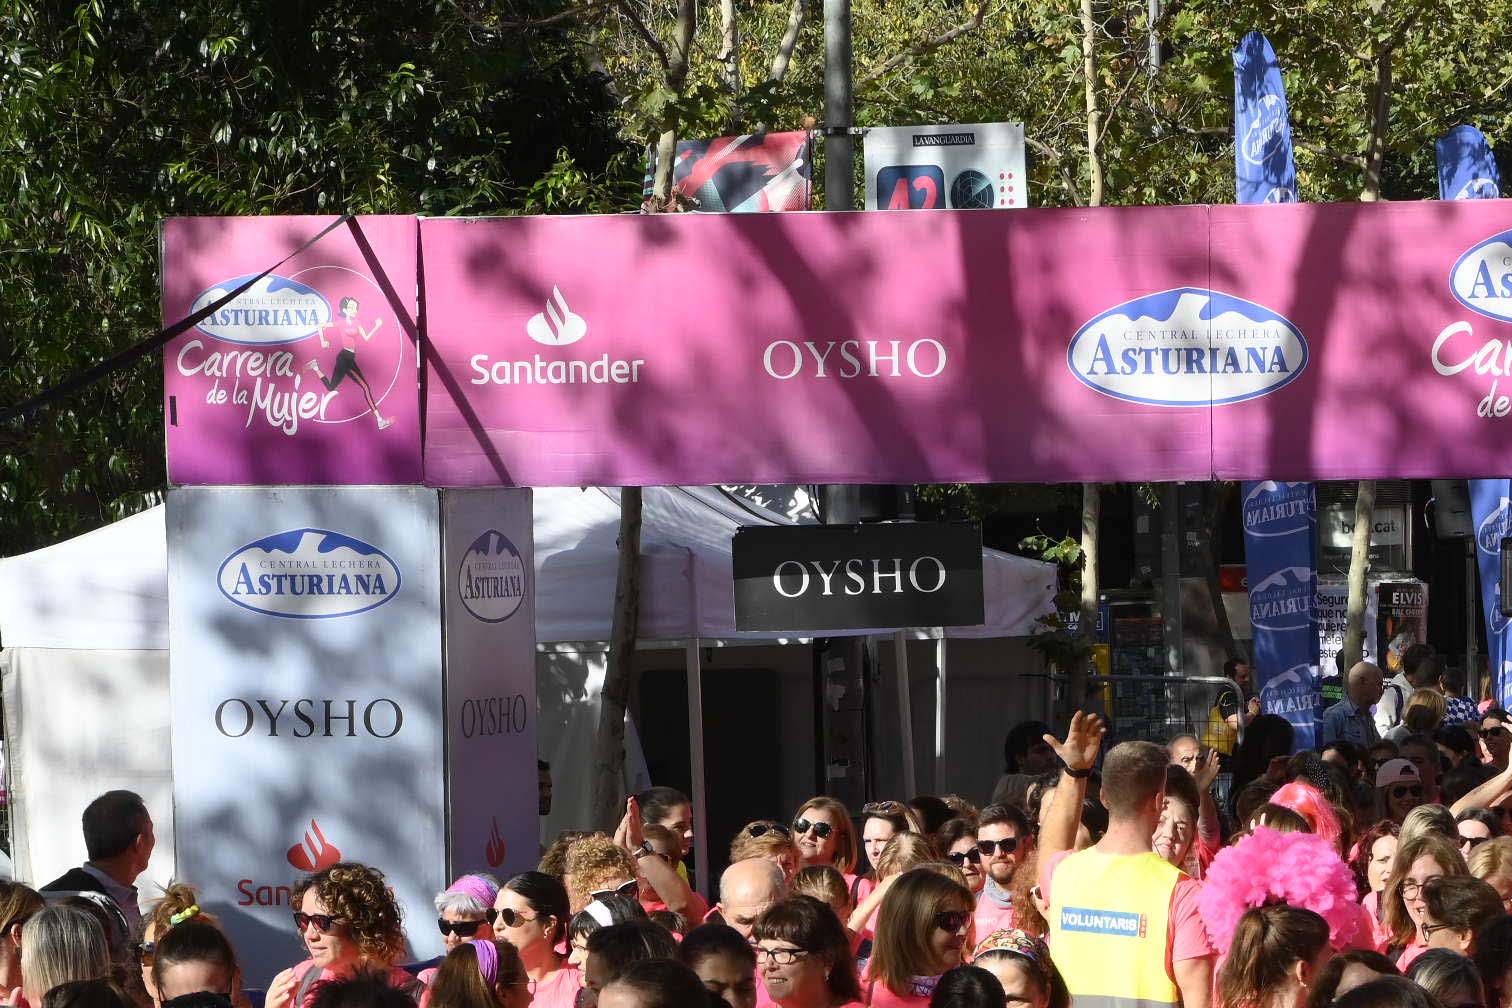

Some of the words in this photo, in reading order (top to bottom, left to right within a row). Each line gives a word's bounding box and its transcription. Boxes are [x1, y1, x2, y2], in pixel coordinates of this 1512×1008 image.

[201, 303, 319, 326] ASTURIANA
[1123, 329, 1201, 341] CENTRAL
[1206, 329, 1282, 341] LECHERA
[177, 340, 295, 377] Carrera
[470, 353, 645, 385] Santander
[763, 338, 947, 379] OYSHO
[1087, 333, 1291, 377] ASTURIANA
[206, 379, 228, 405] de
[232, 378, 249, 405] la
[245, 372, 340, 436] Mujer
[1477, 380, 1512, 420] de
[1341, 519, 1396, 534] b.cat
[232, 562, 388, 596] ASTURIANA
[259, 559, 318, 569] CENTRAL
[323, 558, 382, 569] LECHERA
[463, 563, 522, 601] ASTURIANA
[773, 556, 946, 598] OYSHO
[1392, 592, 1423, 605] ELVIS
[214, 698, 404, 738] OYSHO
[461, 693, 528, 738] OYSHO
[1062, 912, 1138, 931] VOLUNTARIS
